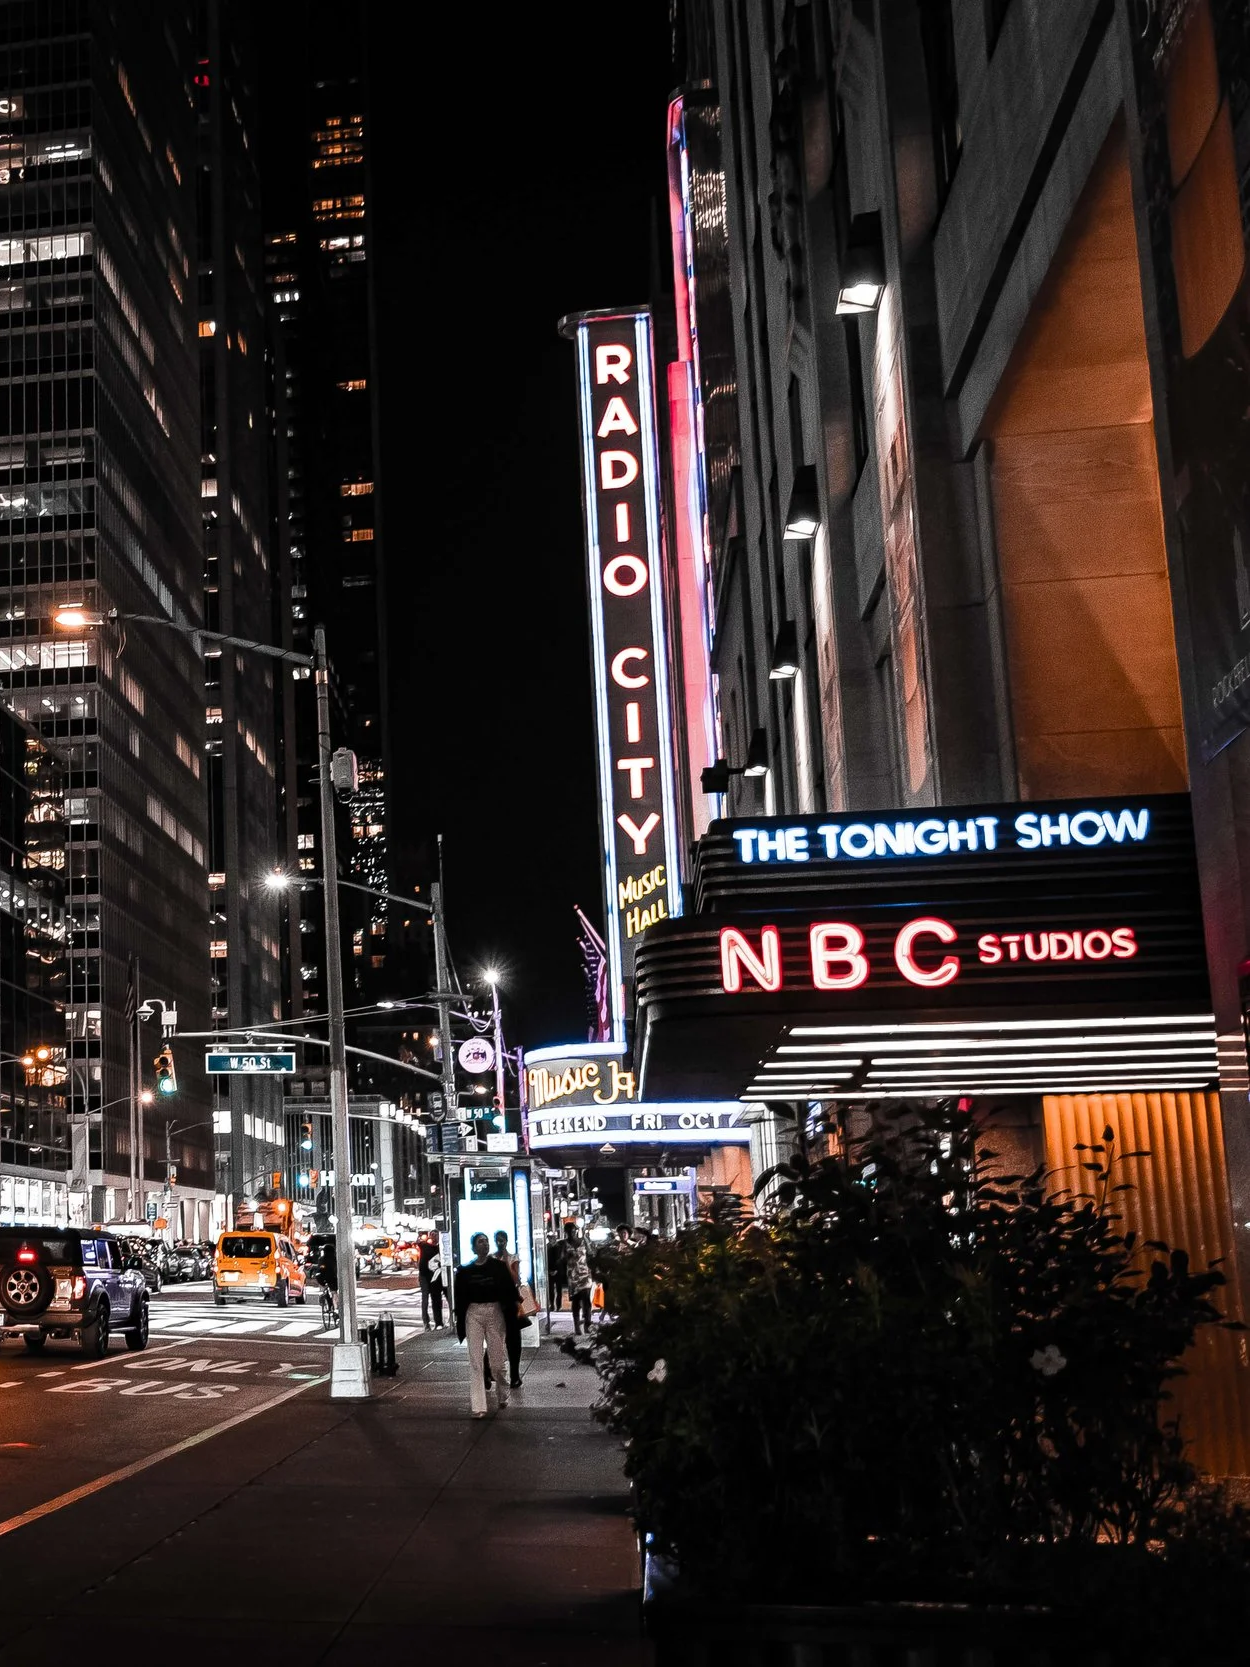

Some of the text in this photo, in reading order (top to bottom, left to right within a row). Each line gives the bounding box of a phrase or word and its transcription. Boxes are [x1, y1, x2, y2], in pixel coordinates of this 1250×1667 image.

[595, 343, 660, 856] RADIO CITY
[732, 808, 1150, 864] THE TONIGHT SHOW
[626, 898, 668, 939] HALL
[718, 916, 1139, 994] NBC STUDIOS
[230, 1057, 271, 1070] W 50 St
[529, 1062, 600, 1107] Music
[473, 1108, 483, 1119] 50
[541, 1114, 607, 1136] WEEKEND
[678, 1113, 722, 1130] OCT
[123, 1357, 323, 1375] ONLY
[45, 1378, 241, 1400] BUS
